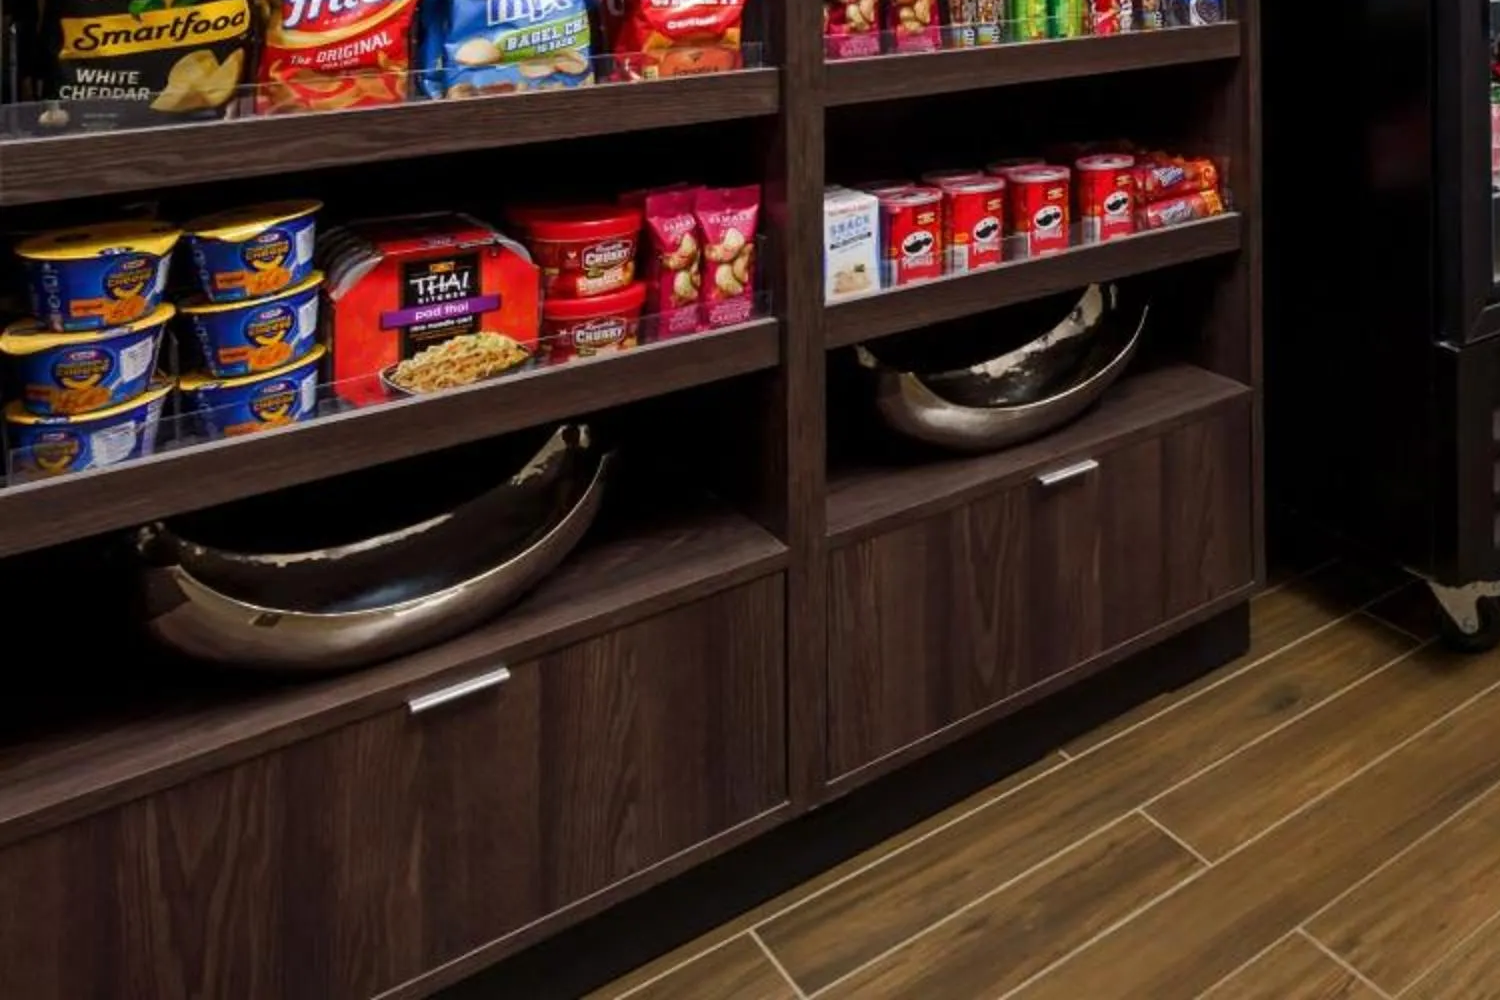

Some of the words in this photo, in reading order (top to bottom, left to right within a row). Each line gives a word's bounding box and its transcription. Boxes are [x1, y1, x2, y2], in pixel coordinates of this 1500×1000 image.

[316, 31, 393, 63] ORIGINAL
[75, 68, 141, 85] WHITE
[59, 85, 151, 101] CHEDDAR
[409, 270, 470, 296] THAI
[415, 305, 441, 320] pad
[444, 300, 469, 314] thai
